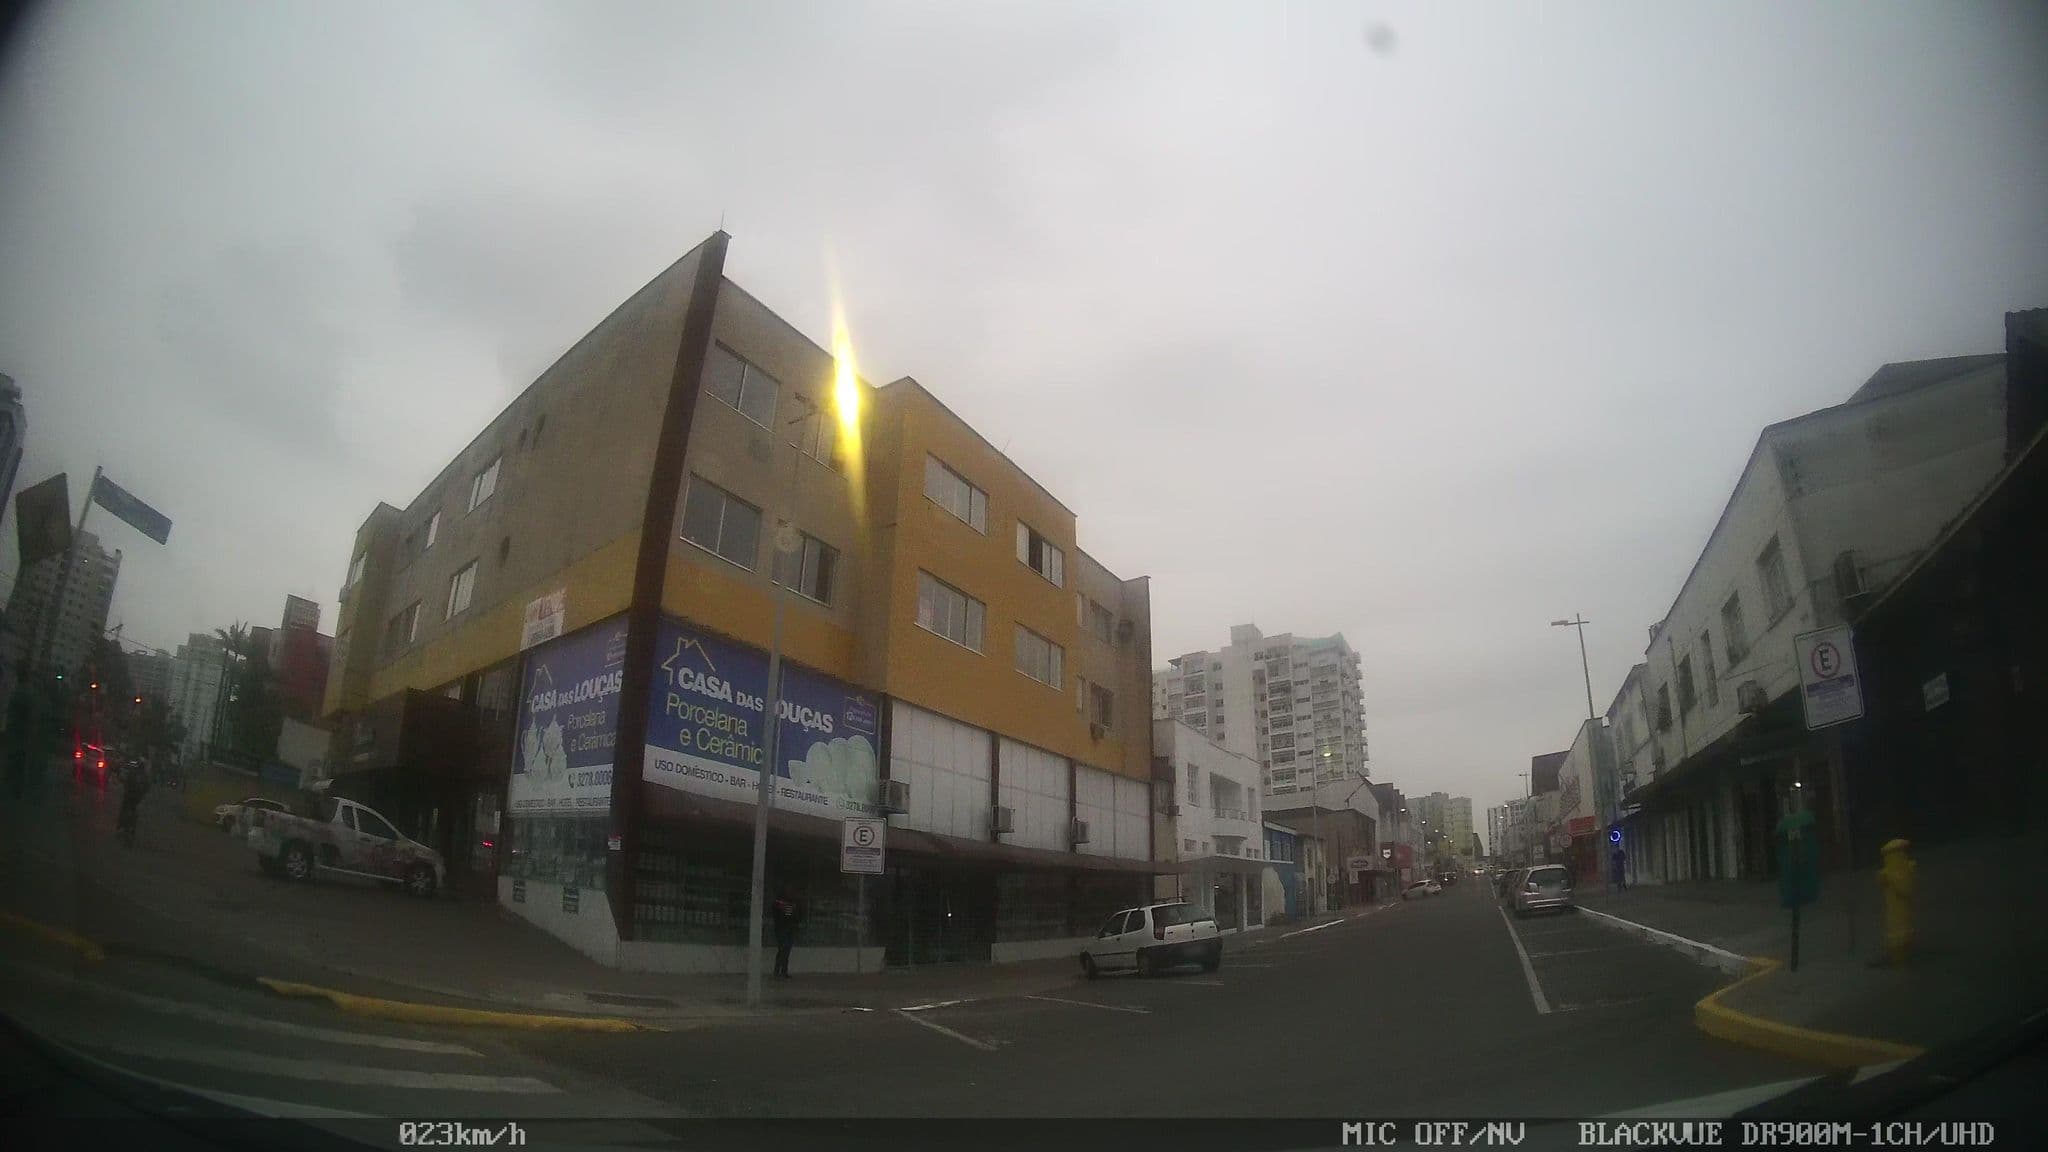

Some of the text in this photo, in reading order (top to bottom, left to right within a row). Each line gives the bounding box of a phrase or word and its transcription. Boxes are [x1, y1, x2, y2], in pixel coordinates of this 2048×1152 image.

[1818, 647, 1833, 672] E
[531, 669, 624, 714] CASA DAS LOUÇAS
[678, 667, 834, 734] CASA DAS OUÇAS
[666, 692, 748, 737] Porcelana
[679, 728, 765, 766] e Cerâmic
[654, 759, 673, 773] USO
[675, 764, 724, 784] DOMÉSTICO
[730, 776, 747, 790] BAR
[780, 787, 829, 806] RESTAURANTE
[860, 829, 868, 842] E
